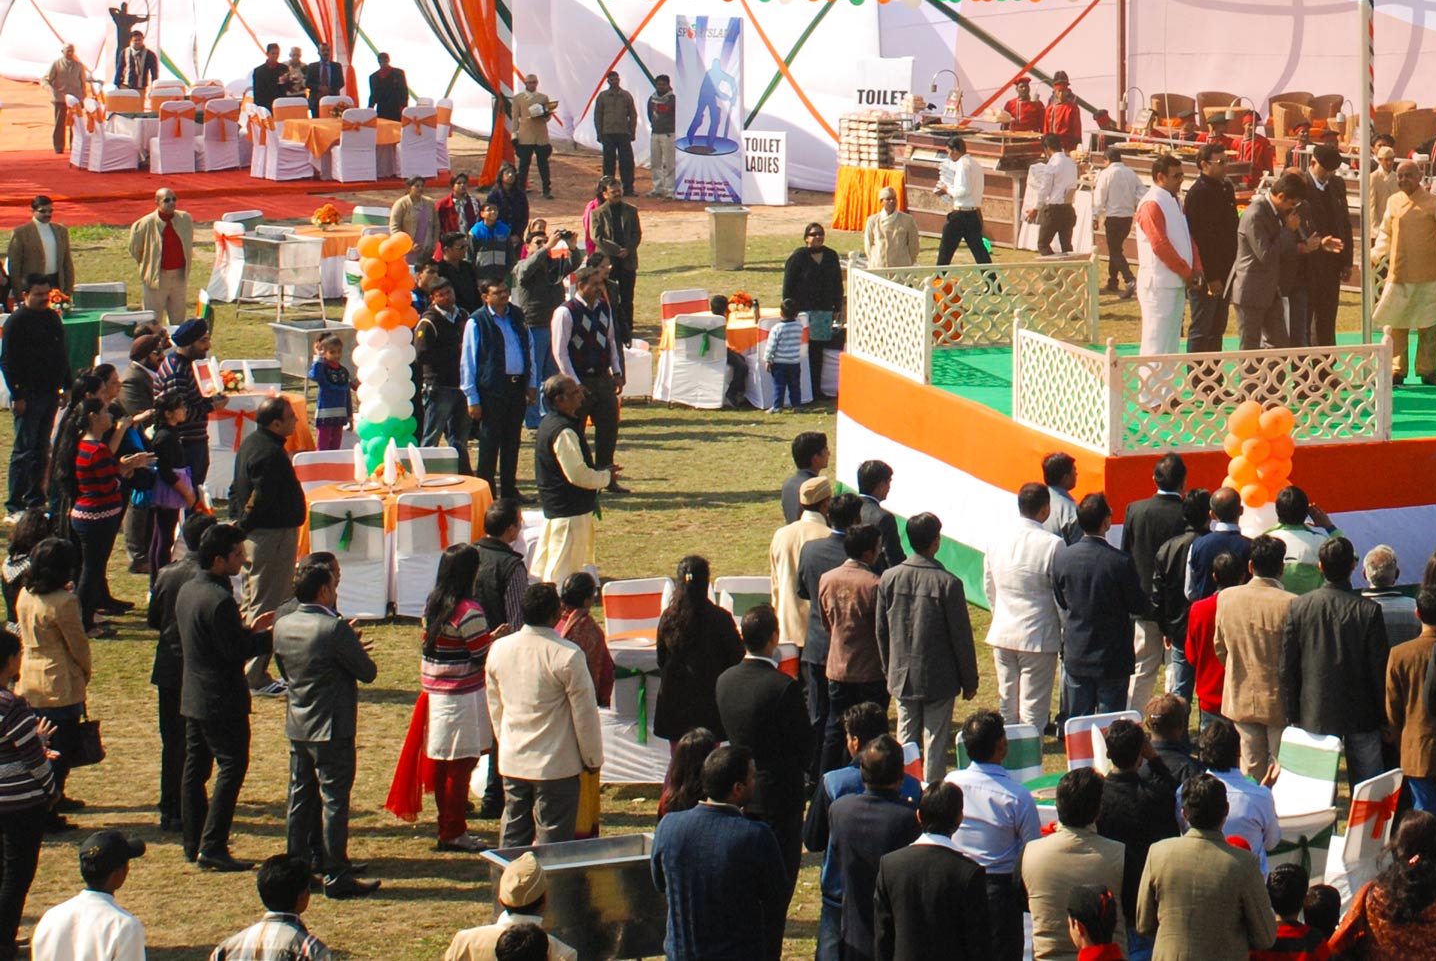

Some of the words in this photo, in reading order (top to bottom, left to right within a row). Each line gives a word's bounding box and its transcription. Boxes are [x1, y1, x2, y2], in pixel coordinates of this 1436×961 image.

[857, 89, 908, 105] TOILET
[745, 138, 781, 153] TOILET
[745, 156, 780, 174] LADIES
